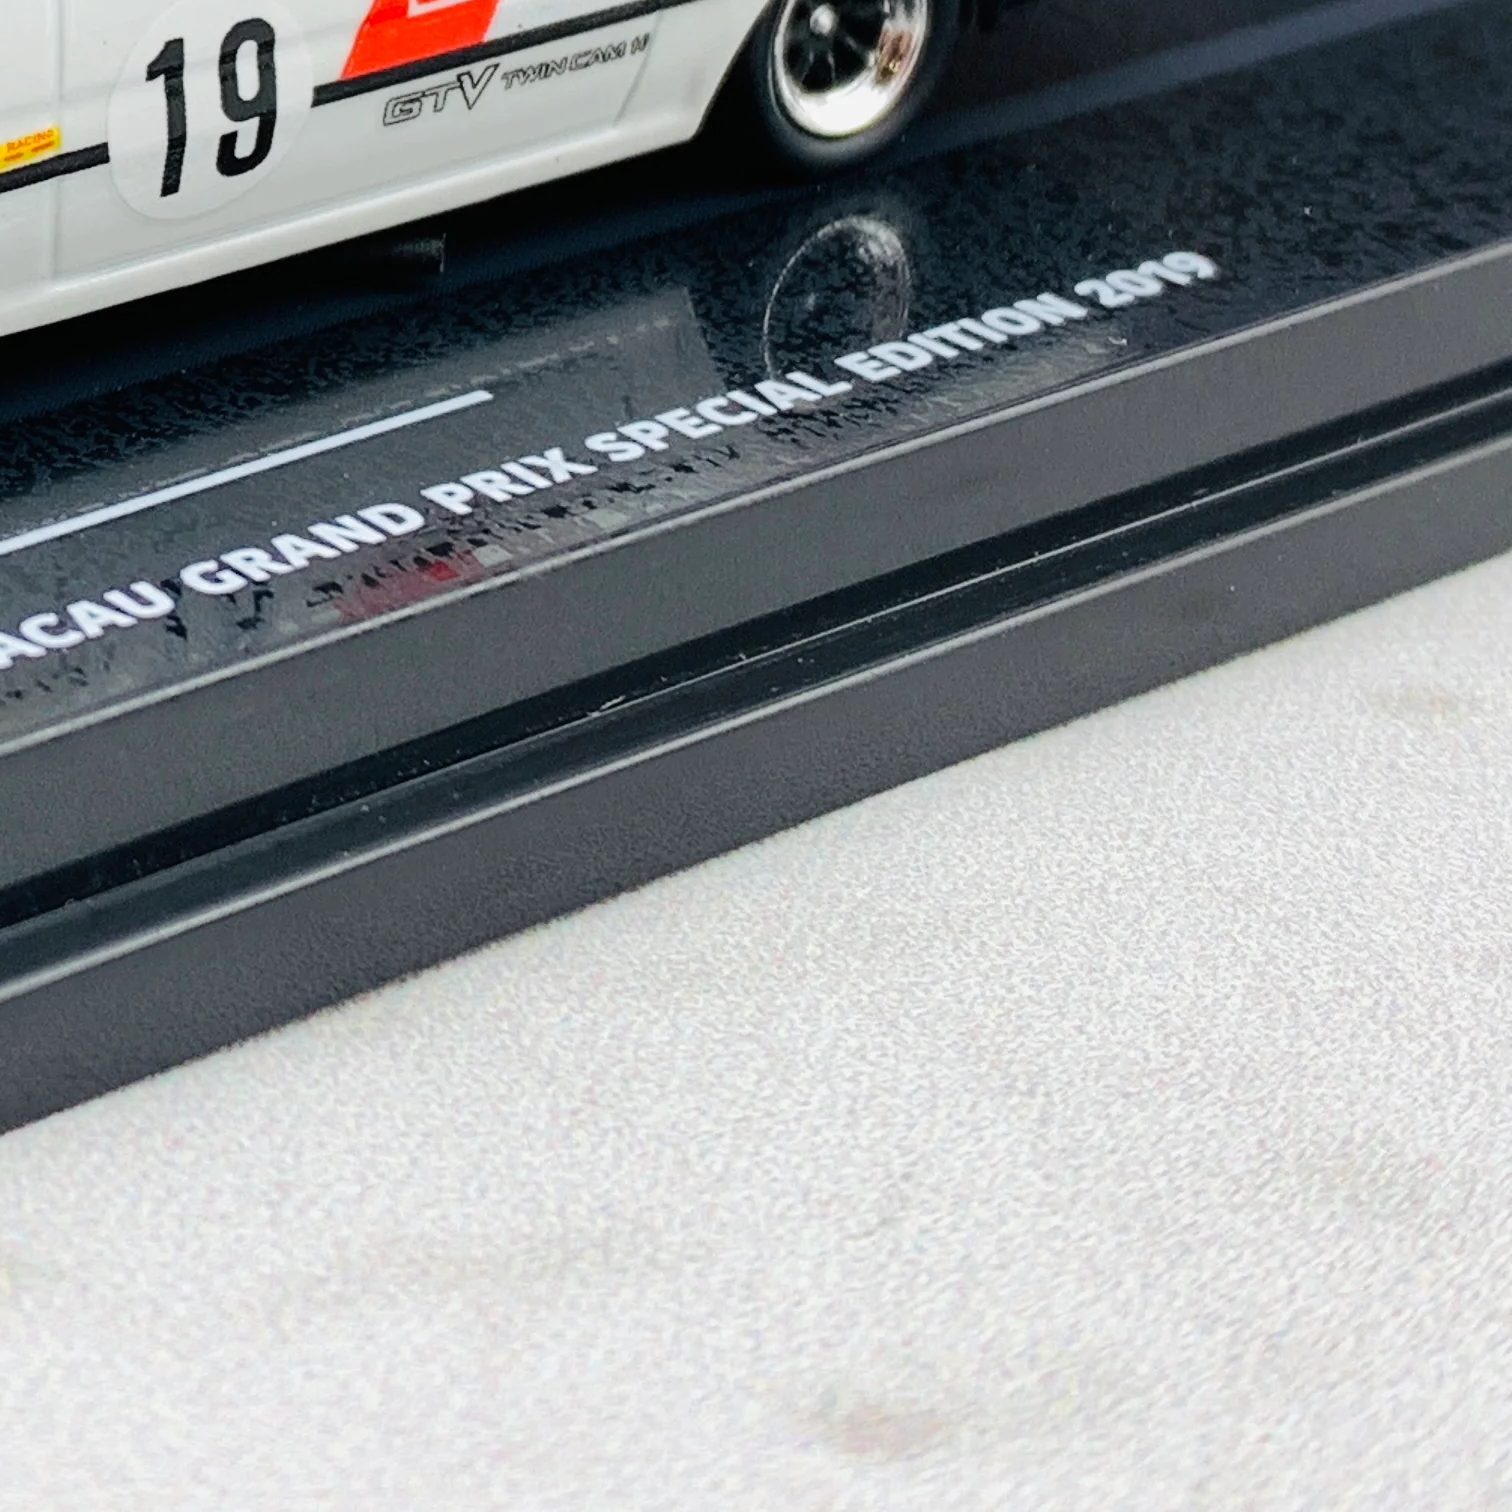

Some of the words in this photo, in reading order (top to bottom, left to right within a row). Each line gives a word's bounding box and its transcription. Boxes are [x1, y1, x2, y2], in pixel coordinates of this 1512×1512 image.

[145, 17, 277, 198] 19
[382, 62, 500, 126] GTV
[180, 504, 426, 595] GRAND
[421, 446, 598, 516] PRIX
[585, 371, 854, 462] SPECIAL
[833, 292, 1088, 383] EDITION
[1073, 250, 1221, 308] 2019
